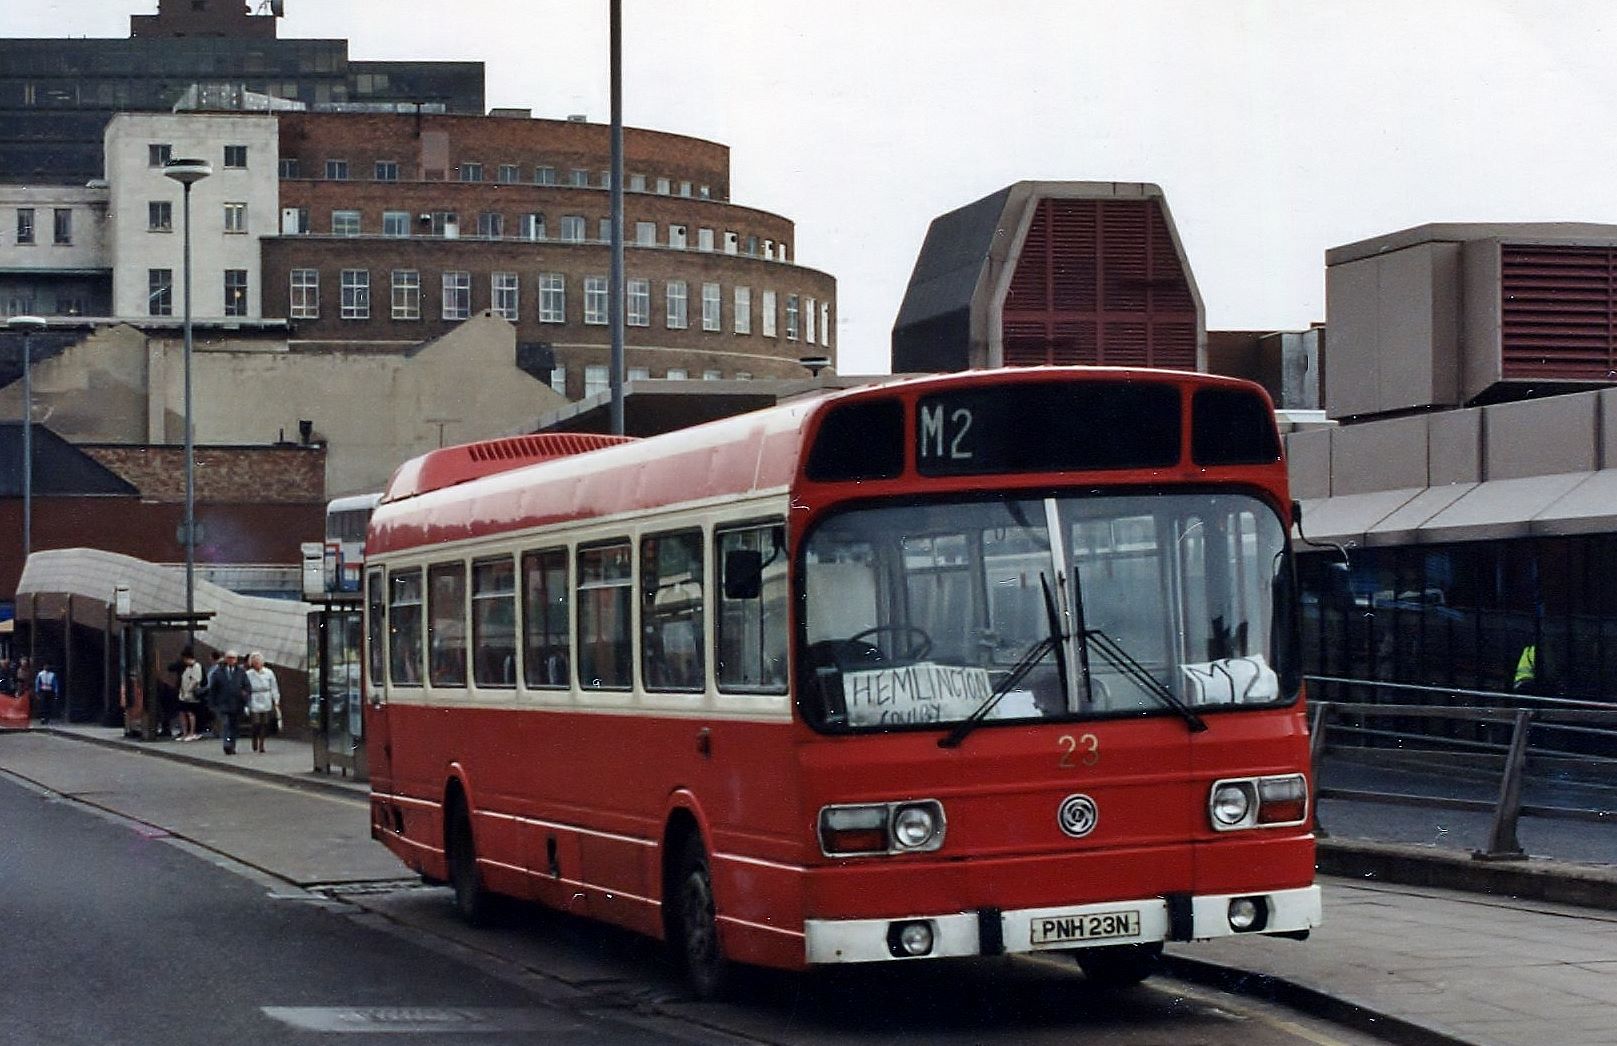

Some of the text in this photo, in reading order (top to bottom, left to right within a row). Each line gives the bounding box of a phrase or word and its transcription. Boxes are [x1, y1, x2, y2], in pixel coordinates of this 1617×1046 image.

[921, 405, 973, 459] M2
[1187, 656, 1271, 704] M2
[1058, 733, 1099, 768] 23
[1042, 914, 1130, 939] PNH 23N
